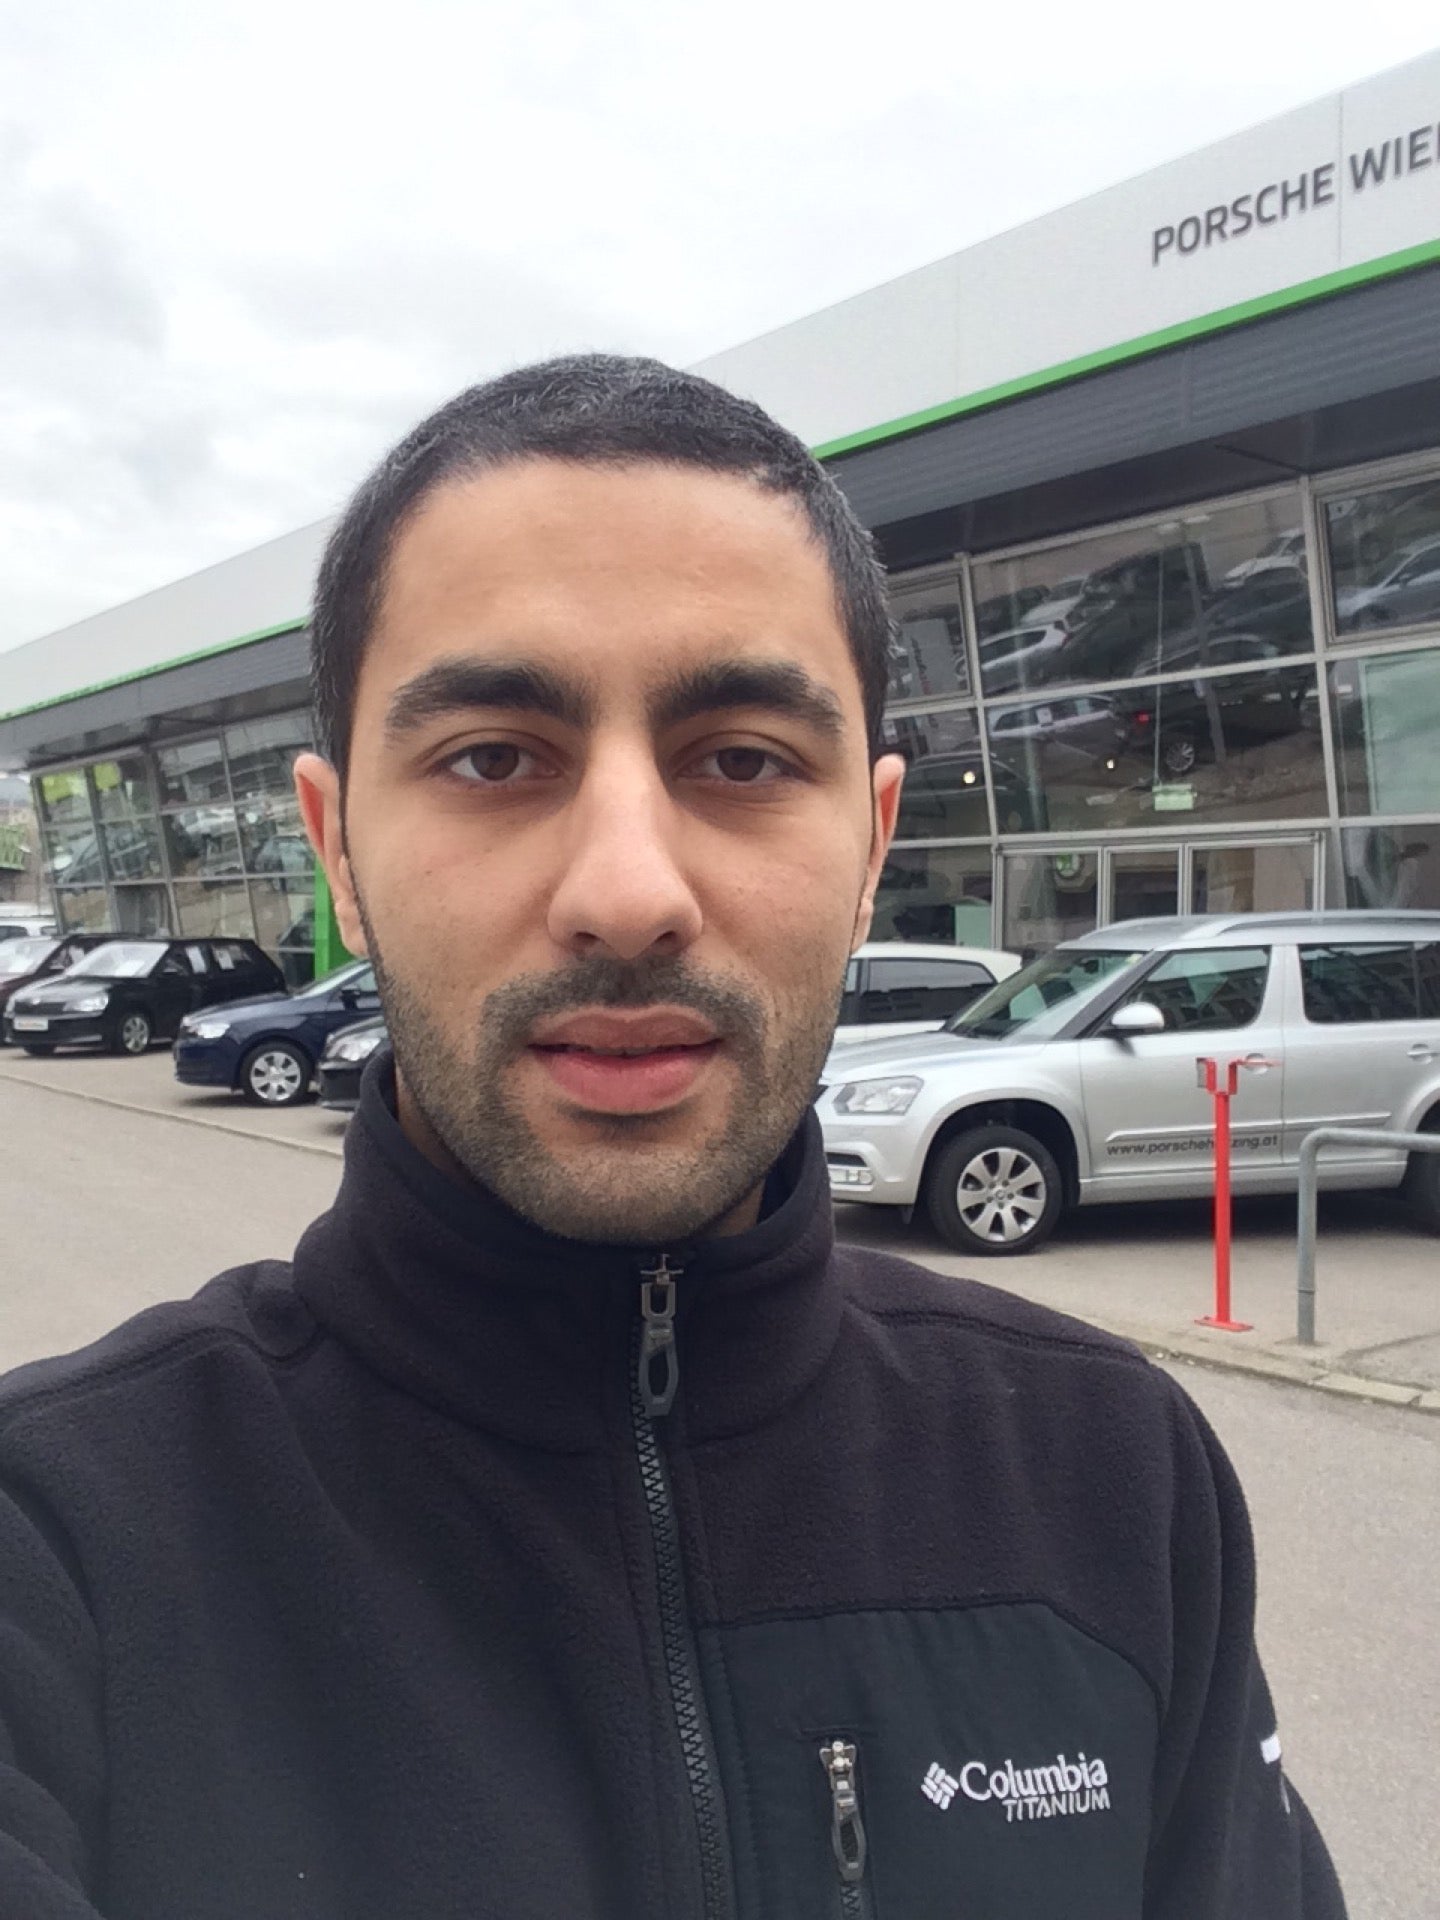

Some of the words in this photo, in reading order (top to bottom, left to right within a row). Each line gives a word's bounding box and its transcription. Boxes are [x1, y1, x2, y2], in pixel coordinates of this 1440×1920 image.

[1152, 162, 1335, 267] PORSCHE
[1349, 121, 1440, 191] WIE
[1106, 1134, 1278, 1156] www.porschehzing.at
[959, 1752, 1108, 1801] Columbia
[1001, 1787, 1110, 1823] TITANIUM
